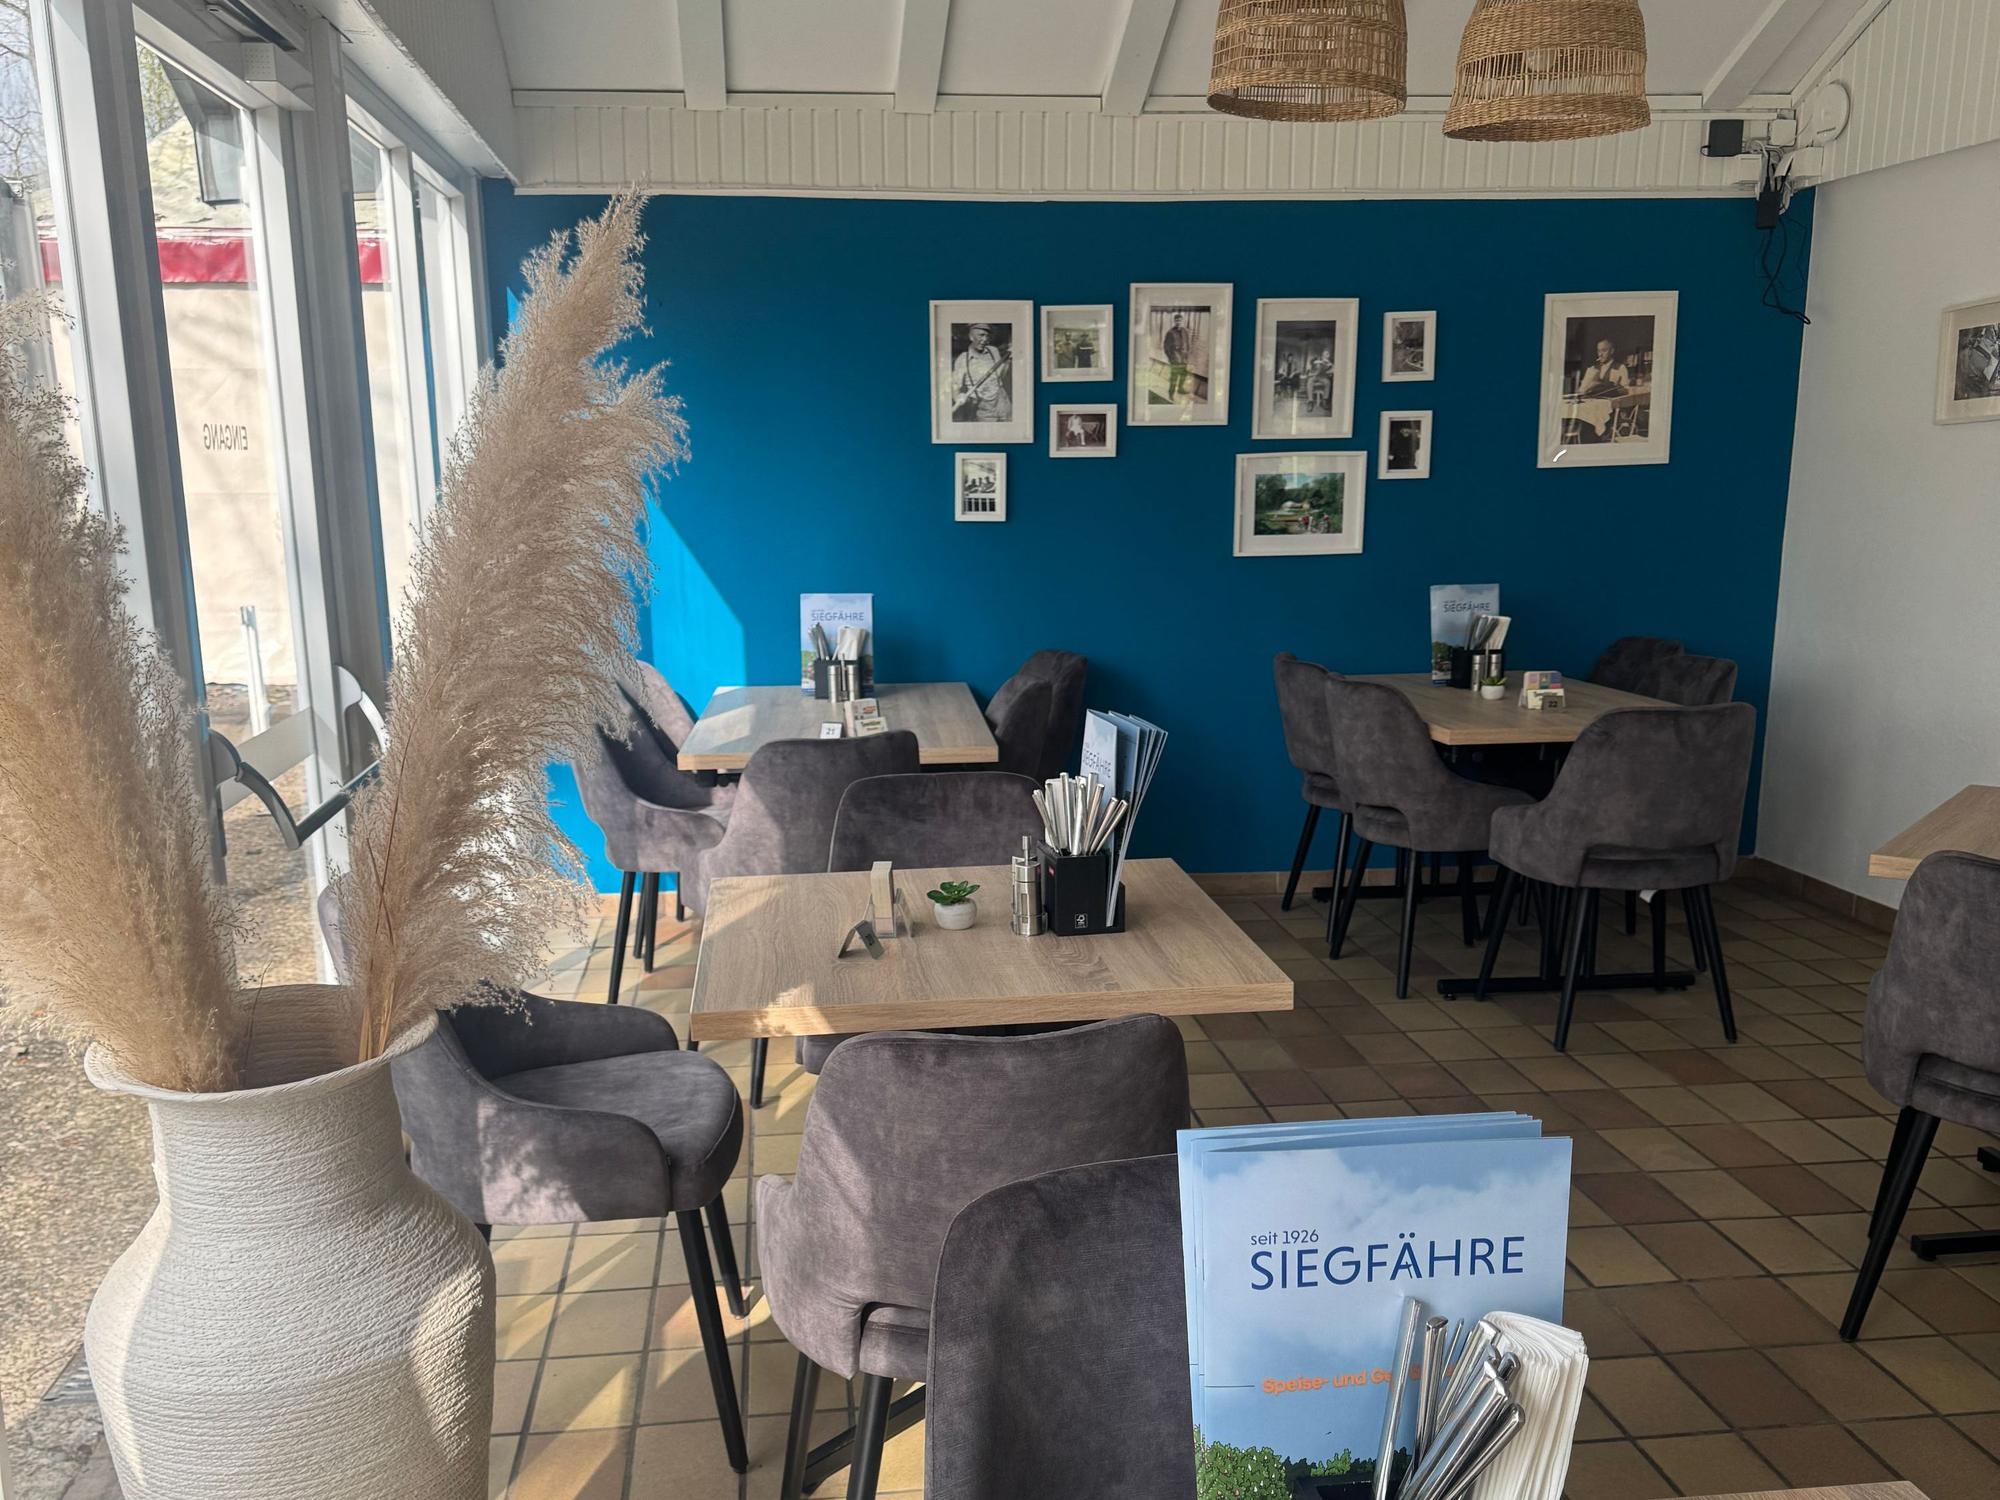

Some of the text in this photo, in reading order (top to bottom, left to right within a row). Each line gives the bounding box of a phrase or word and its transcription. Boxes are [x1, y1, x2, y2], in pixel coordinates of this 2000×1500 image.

[811, 609, 865, 622] SIEGFÄHRE
[1250, 1229, 1319, 1246] seit 1926
[1250, 1232, 1525, 1290] SIEGFÄHRE
[1263, 1374, 1329, 1396] Speise-
[1332, 1369, 1367, 1388] und
